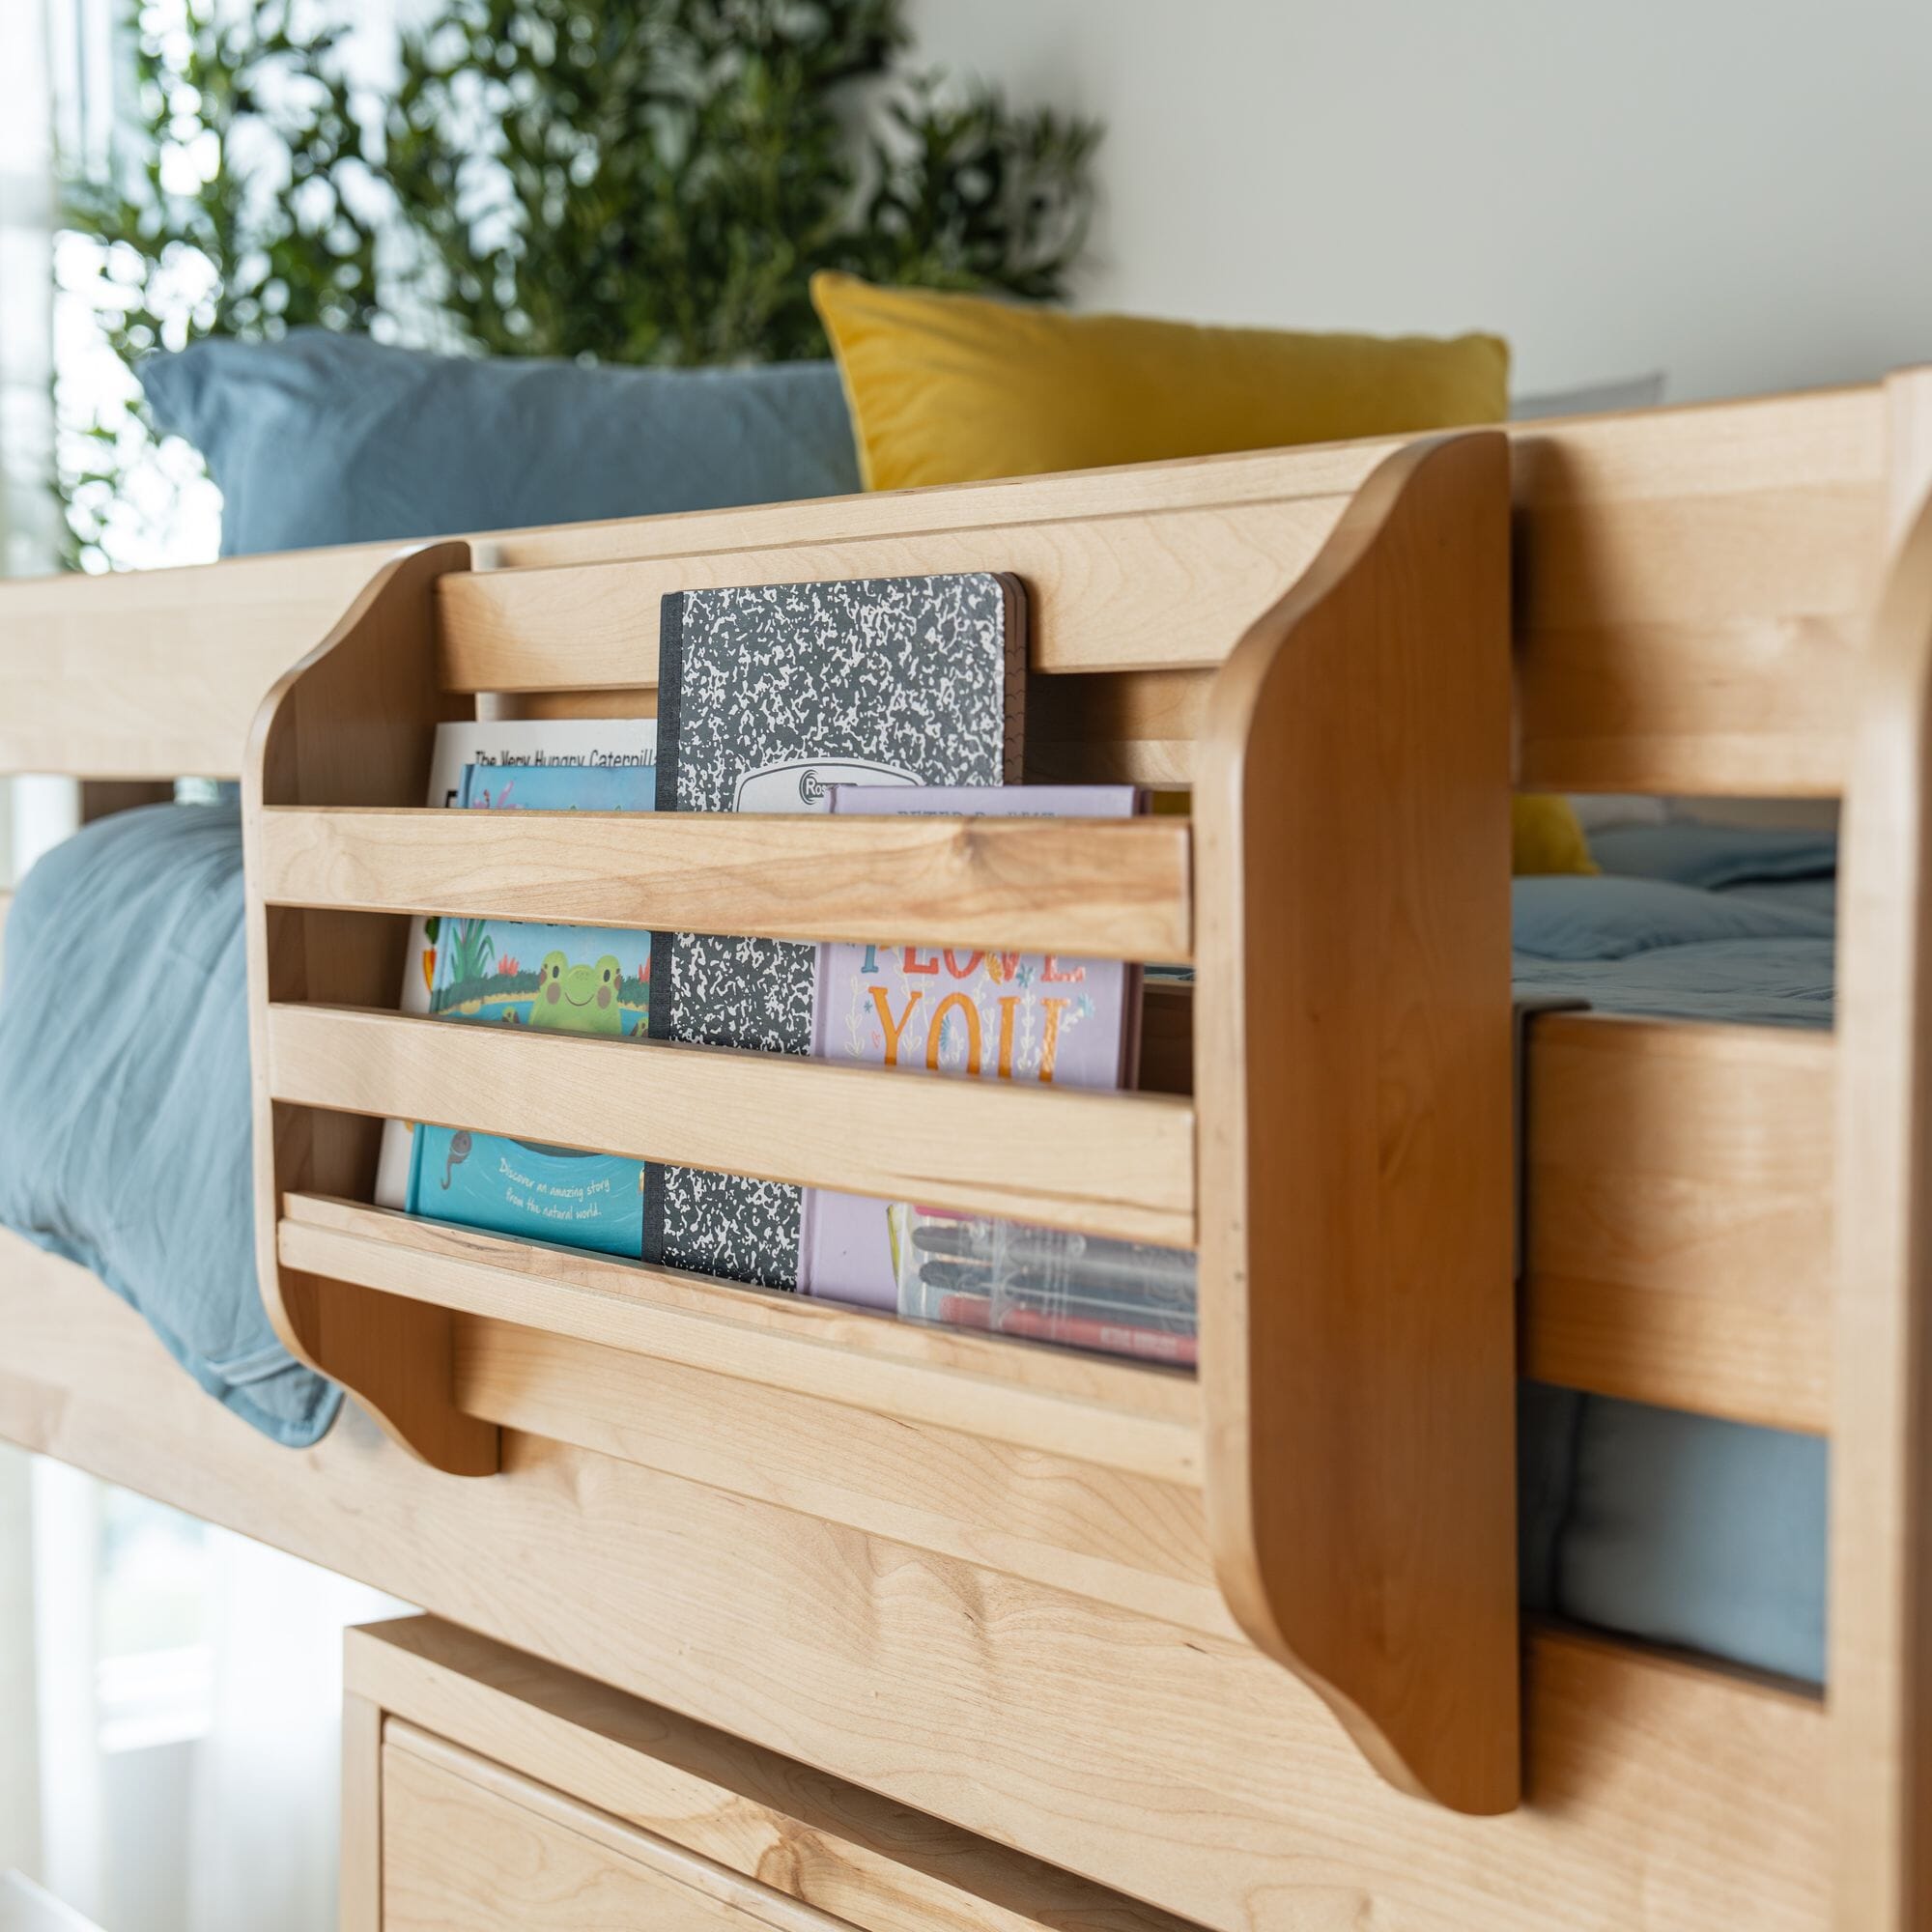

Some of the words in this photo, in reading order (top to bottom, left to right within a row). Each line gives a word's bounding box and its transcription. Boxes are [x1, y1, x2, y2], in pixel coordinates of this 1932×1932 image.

[475, 751, 497, 765] The
[589, 749, 657, 767] Caterpill
[868, 985, 1070, 1082] YOU
[498, 1157, 536, 1189] Discover
[537, 1183, 548, 1194] an
[550, 1185, 584, 1203] amazing
[586, 1178, 611, 1196] story
[506, 1187, 524, 1208] from
[527, 1197, 542, 1214] the
[543, 1204, 574, 1220] natural
[576, 1203, 602, 1220] world.
